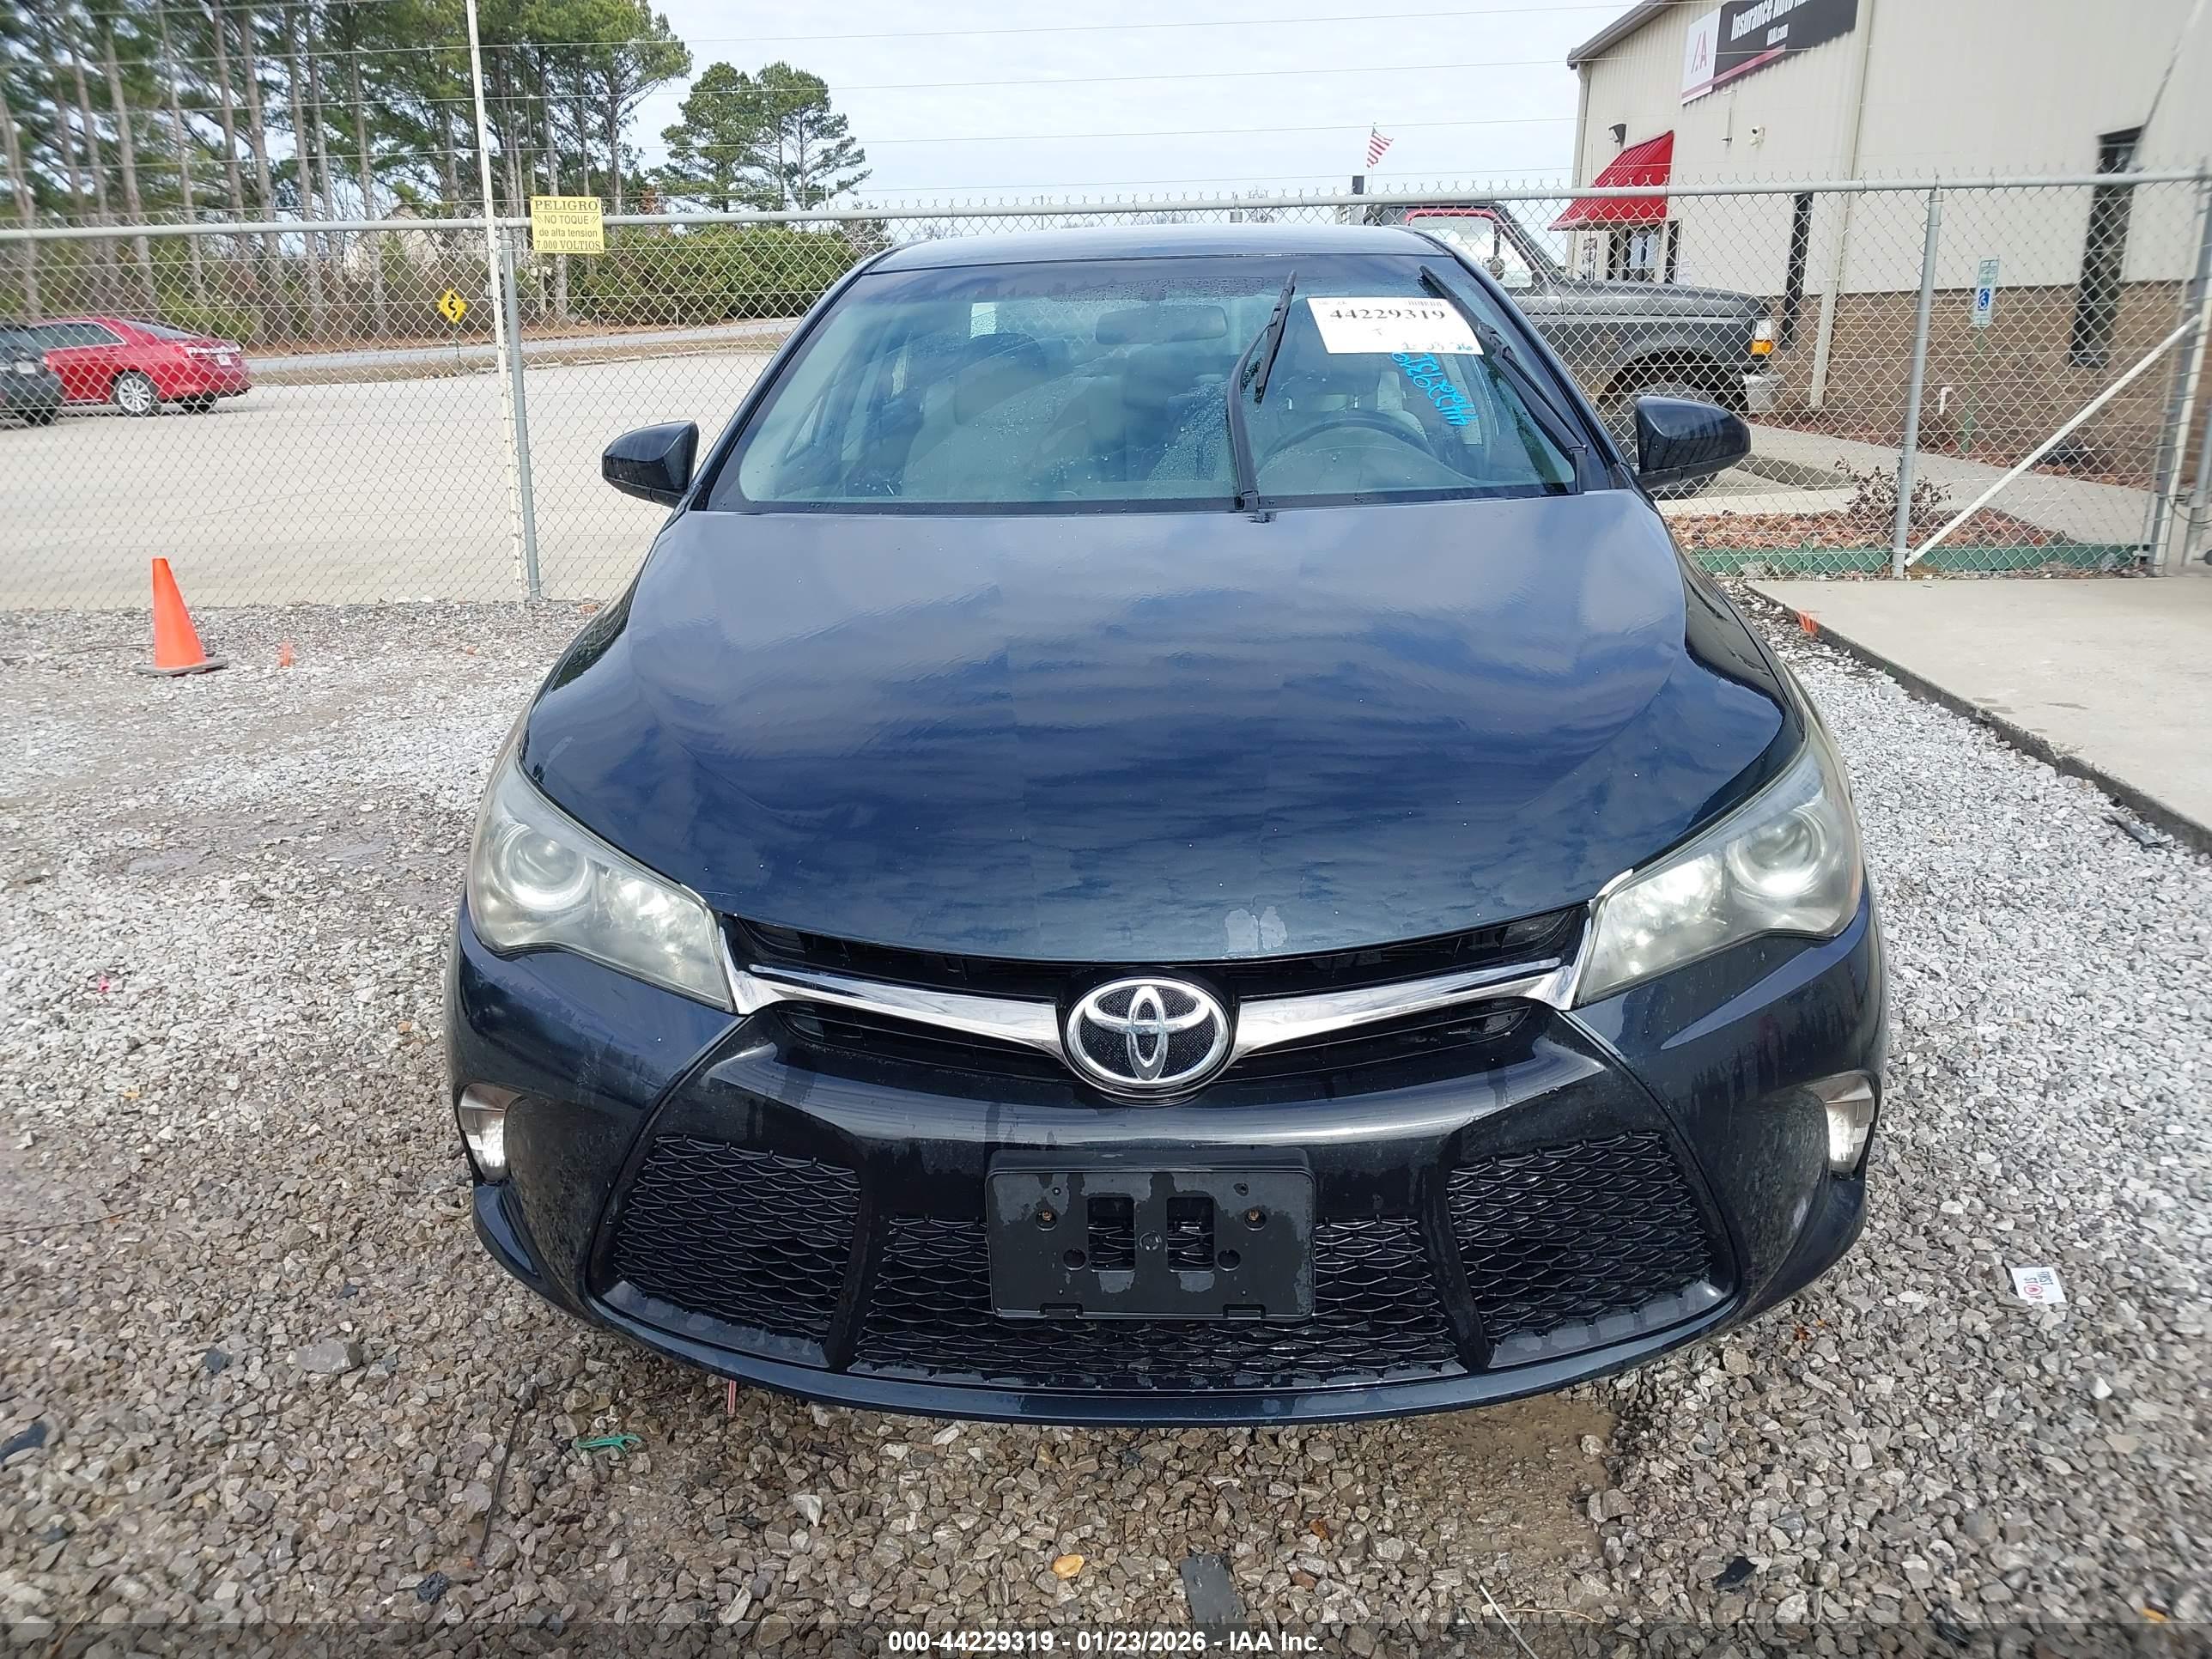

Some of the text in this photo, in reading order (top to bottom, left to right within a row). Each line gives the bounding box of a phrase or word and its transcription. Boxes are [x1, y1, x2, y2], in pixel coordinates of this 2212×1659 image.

[1730, 0, 1773, 42] Insurance
[534, 200, 599, 210] PELIGRO
[544, 216, 589, 225] NO TOQUE
[539, 228, 598, 237] de alta tension
[559, 240, 601, 250] VOLTIOS
[1329, 308, 1446, 321] 44229319
[2036, 1271, 2054, 1285] FIRST
